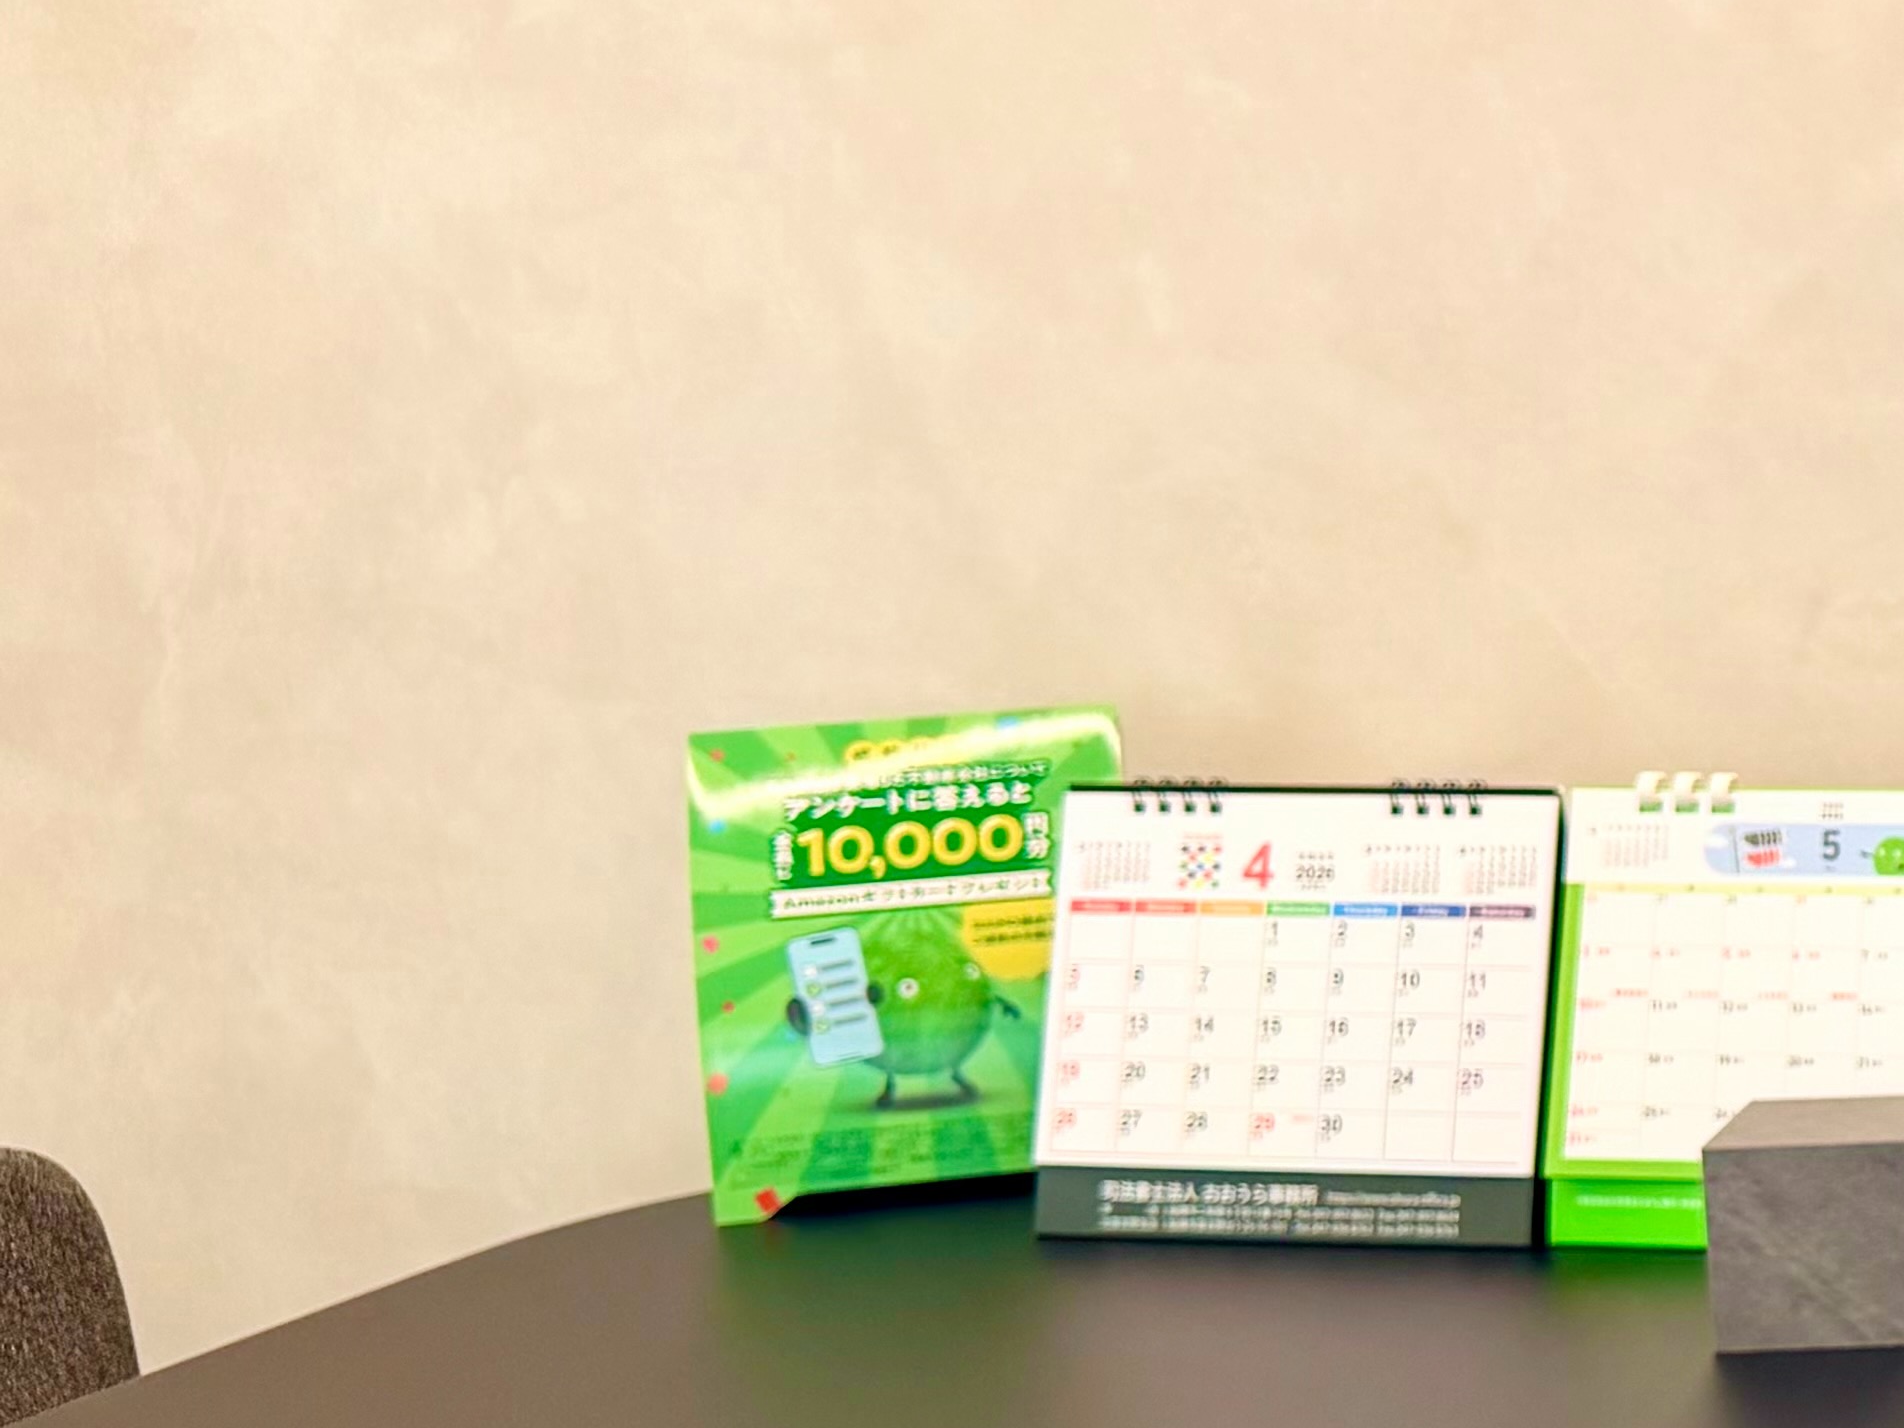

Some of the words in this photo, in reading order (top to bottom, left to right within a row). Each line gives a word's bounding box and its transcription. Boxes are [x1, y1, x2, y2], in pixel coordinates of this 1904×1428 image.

[784, 780, 1032, 821] アンケートに答えると
[797, 814, 1025, 879] 10,000
[1242, 841, 1275, 889] 4
[1822, 829, 1841, 861] 5
